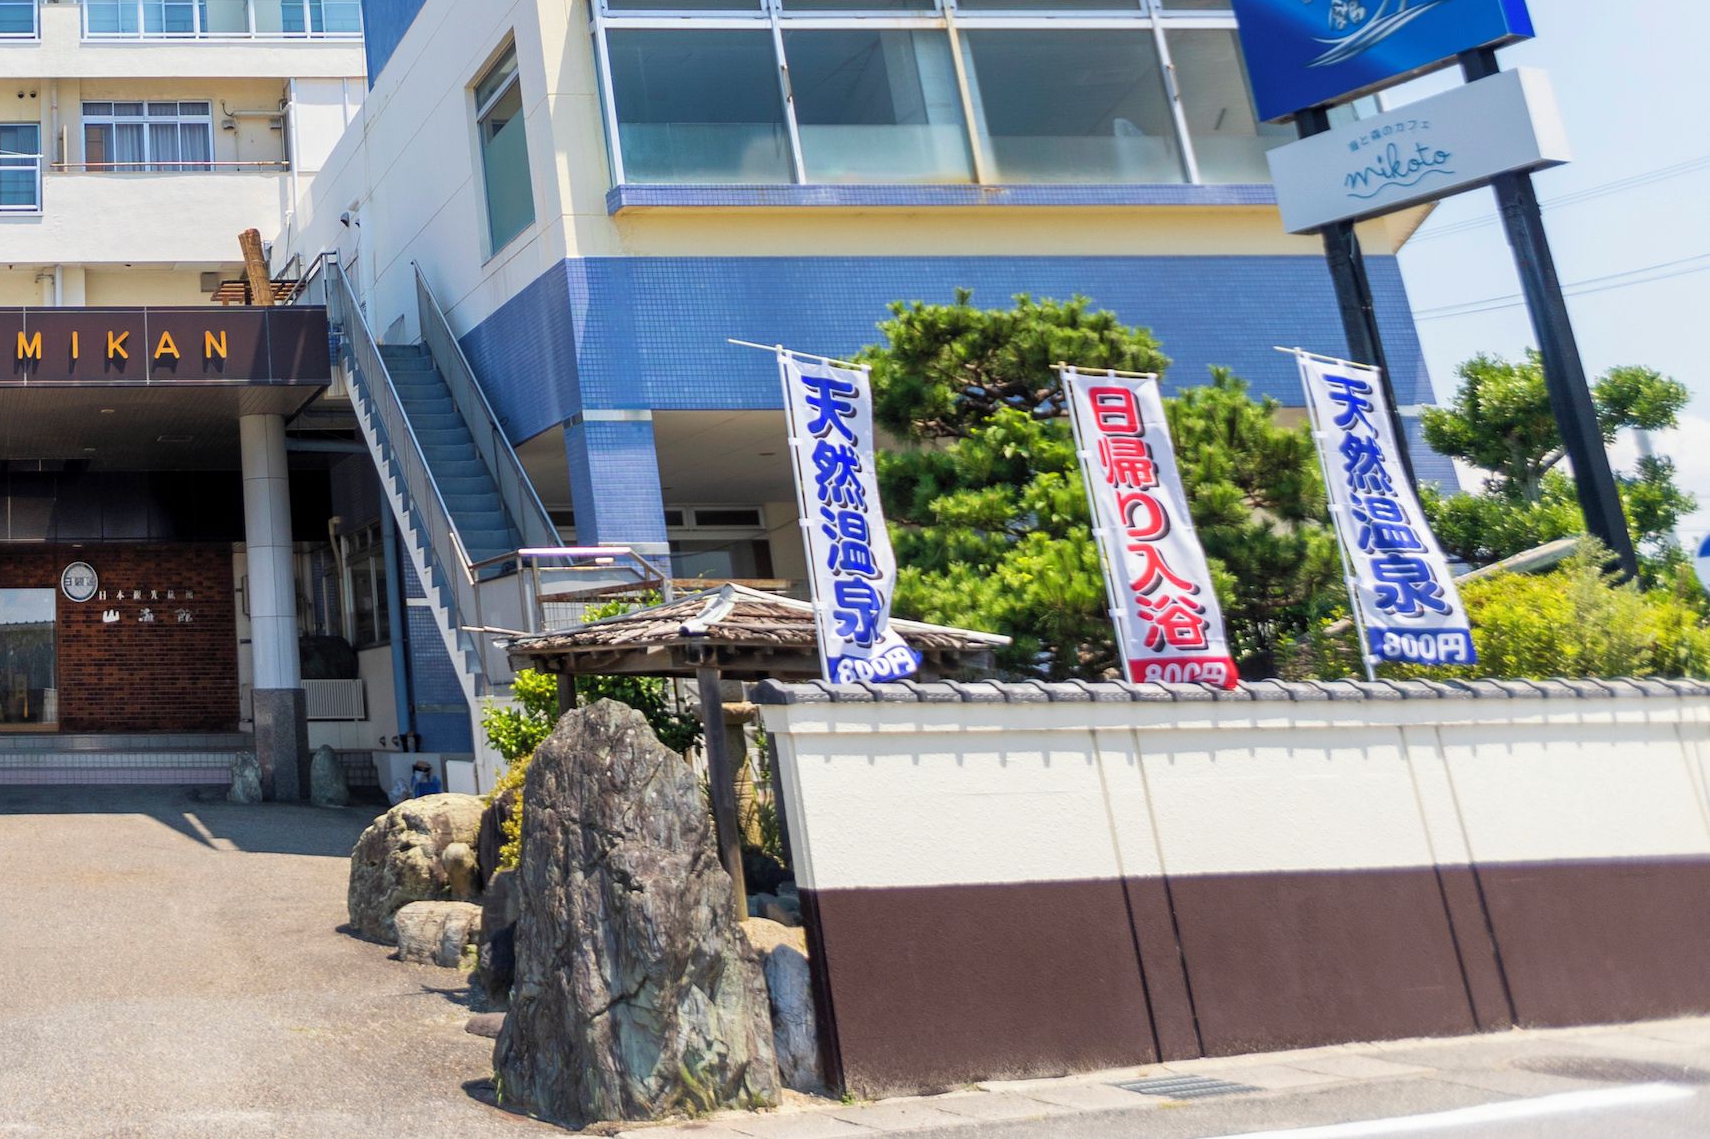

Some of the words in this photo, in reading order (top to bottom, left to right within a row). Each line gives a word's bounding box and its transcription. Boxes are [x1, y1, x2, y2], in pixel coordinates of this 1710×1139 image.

[1344, 143, 1451, 189] mikoto
[800, 374, 882, 647] 天然温泉
[1088, 386, 1209, 651] 日帰り入浴
[1322, 373, 1452, 617] 天然温泉
[837, 646, 916, 684] 800円
[1383, 632, 1466, 662] 800円
